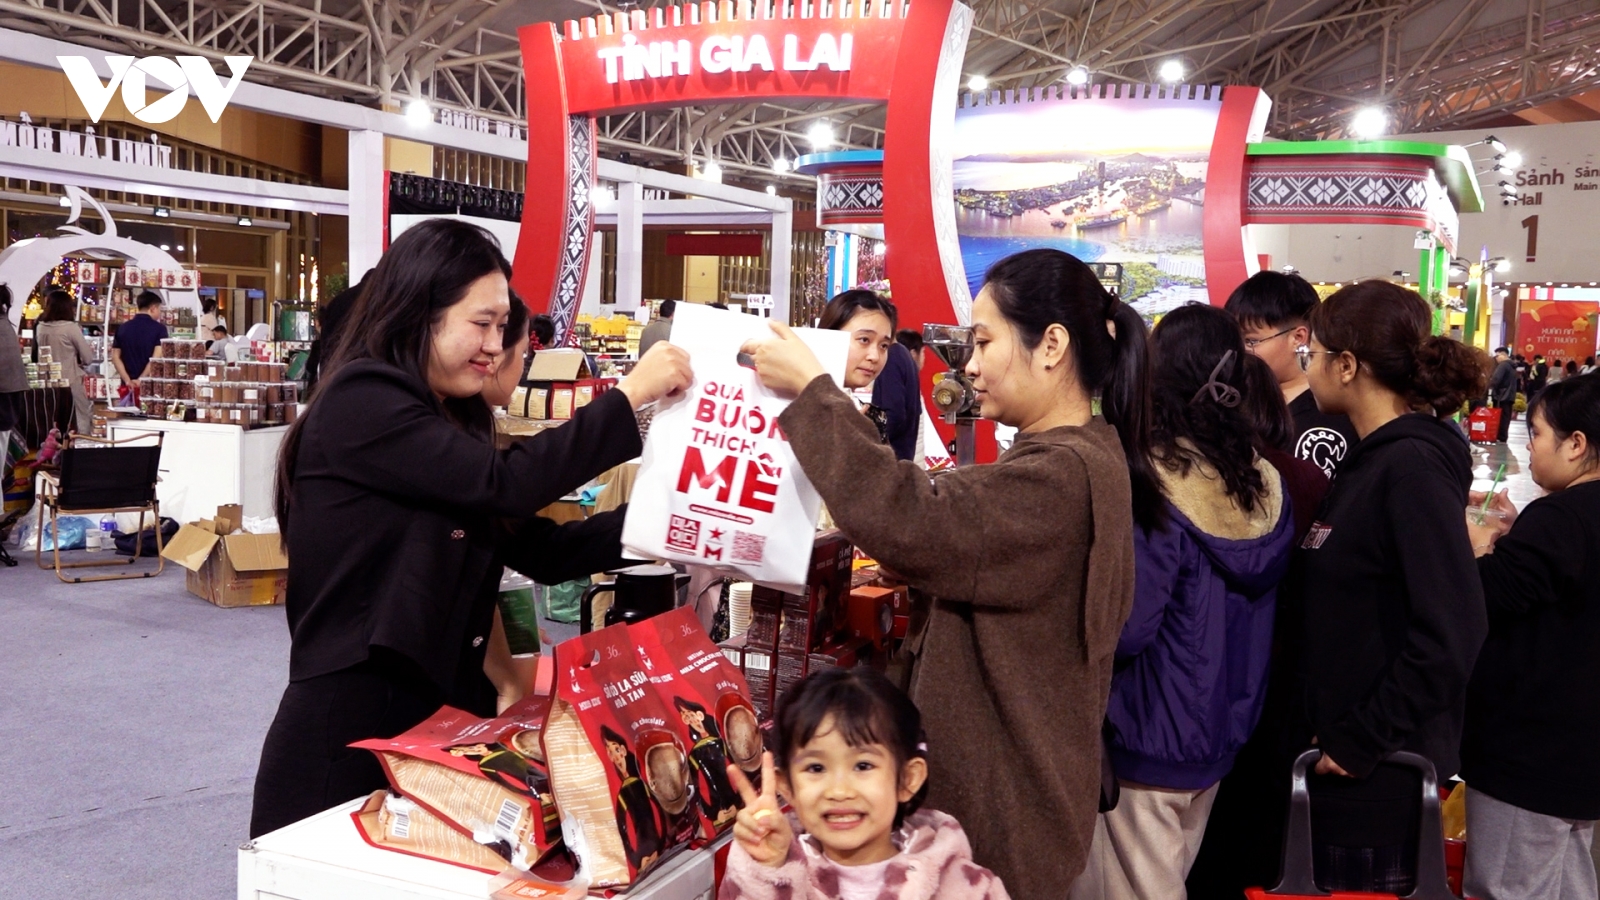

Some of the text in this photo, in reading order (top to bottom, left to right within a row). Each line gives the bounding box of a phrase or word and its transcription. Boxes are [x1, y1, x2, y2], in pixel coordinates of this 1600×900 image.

[598, 33, 853, 84] TỈNH GIA LAI
[1515, 168, 1564, 187] Sảnh
[1573, 182, 1598, 191] Main
[1521, 214, 1539, 262] 1
[703, 381, 744, 402] QUÀ
[694, 398, 788, 442] BUÔN
[692, 427, 757, 455] THÍCH
[629, 687, 646, 704] TAN
